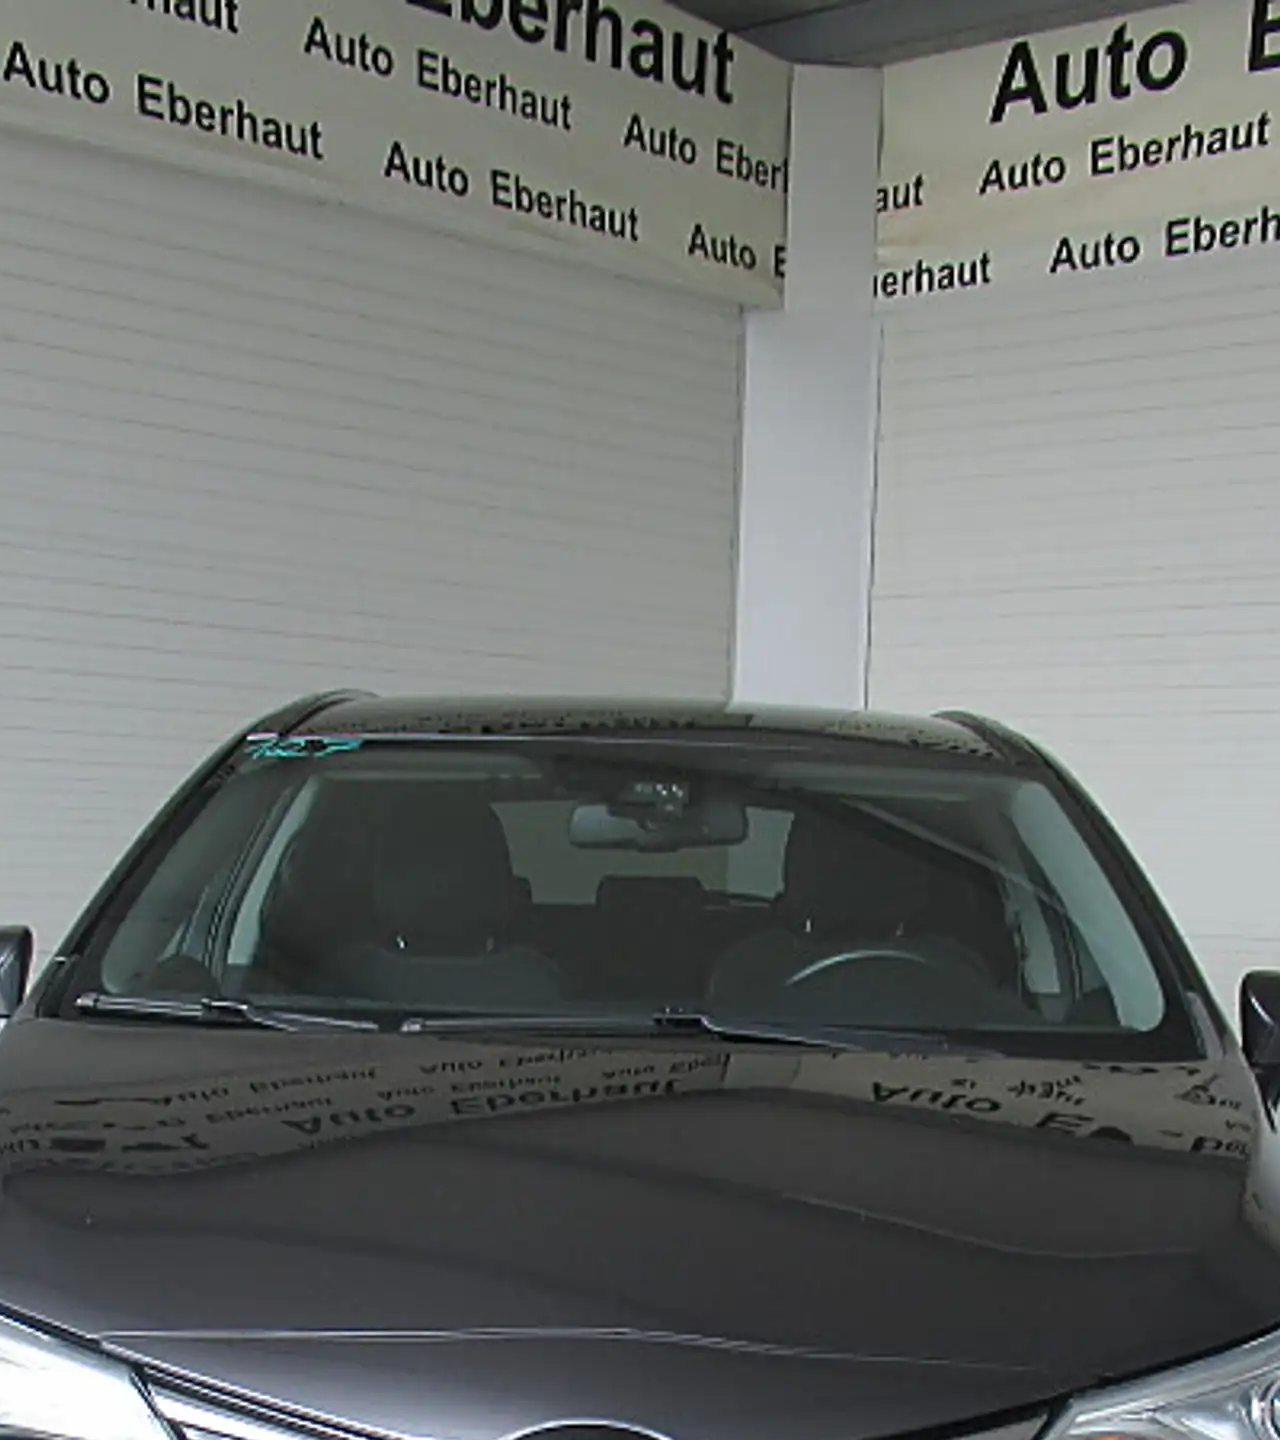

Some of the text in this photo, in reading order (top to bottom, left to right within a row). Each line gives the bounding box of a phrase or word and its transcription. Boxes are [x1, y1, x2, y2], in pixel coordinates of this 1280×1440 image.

[2, 41, 324, 161] Auto Eberhaut
[303, 16, 572, 132] Auto Eberhaut
[988, 21, 1188, 125] Auto
[623, 112, 698, 166] Auto
[978, 111, 1271, 196] Auto Eberhaut
[383, 140, 640, 243] Auto Eberhaut
[687, 222, 758, 272] Auto
[1048, 233, 1142, 275] Auto
